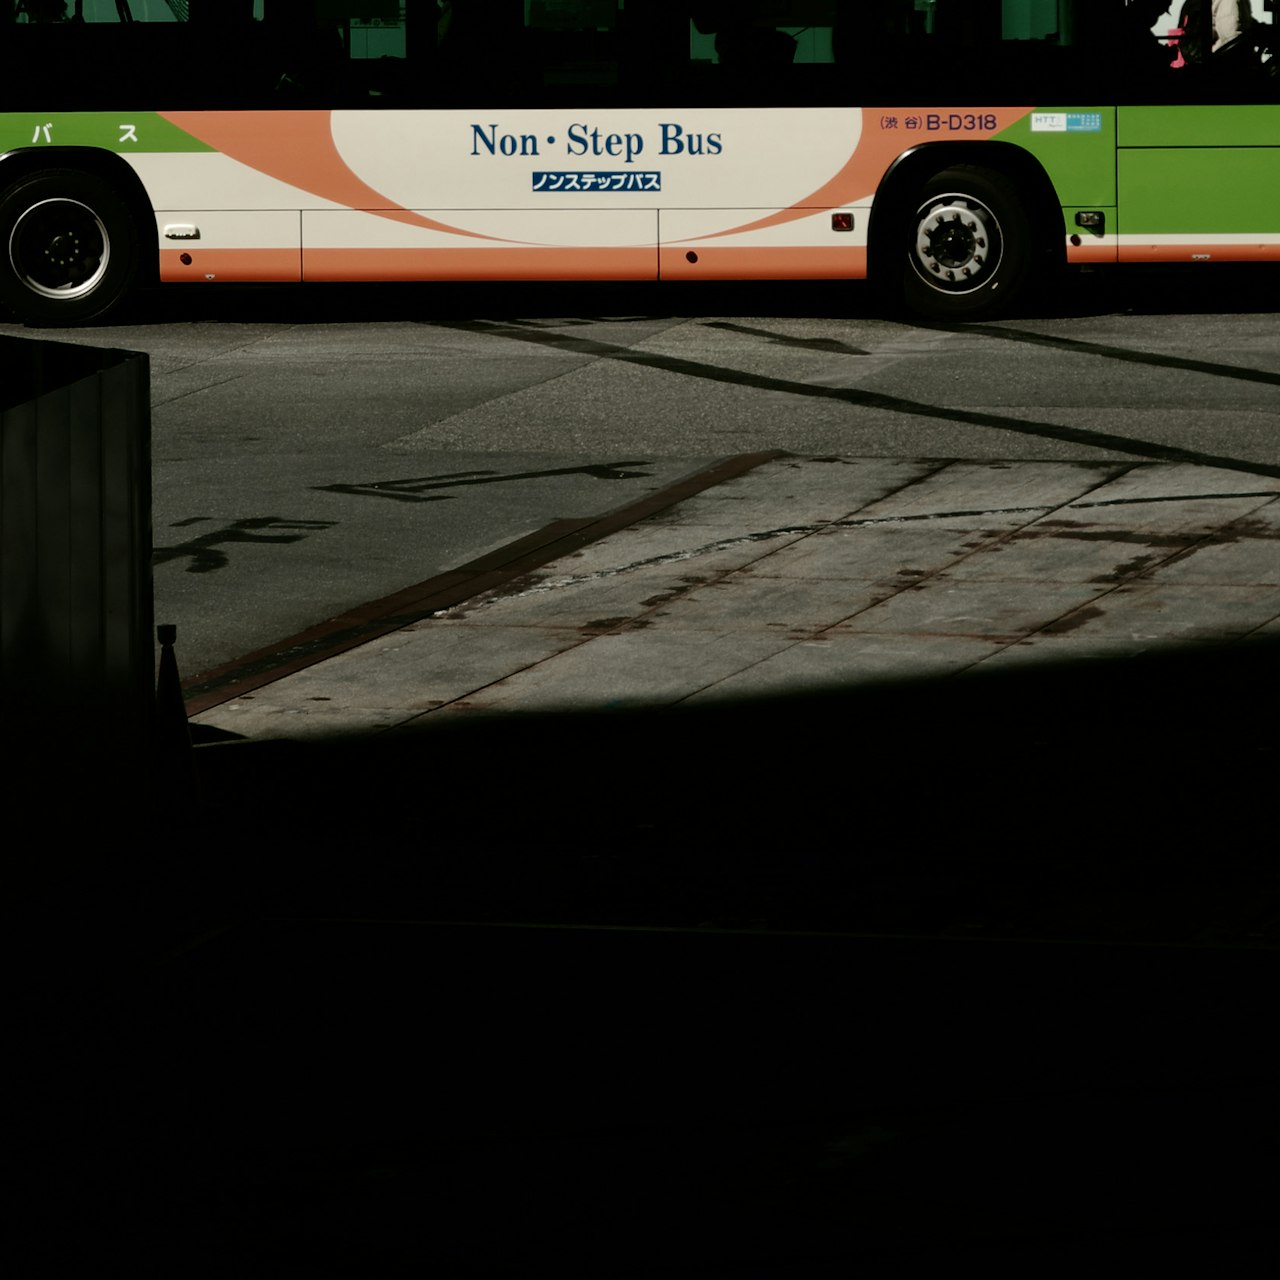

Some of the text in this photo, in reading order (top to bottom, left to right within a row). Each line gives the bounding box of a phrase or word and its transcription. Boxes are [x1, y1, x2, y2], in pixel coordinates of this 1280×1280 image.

[927, 114, 997, 131] B-D318
[567, 123, 644, 163] Step
[658, 123, 723, 156] Bus
[533, 173, 661, 191] ノンステップバス
